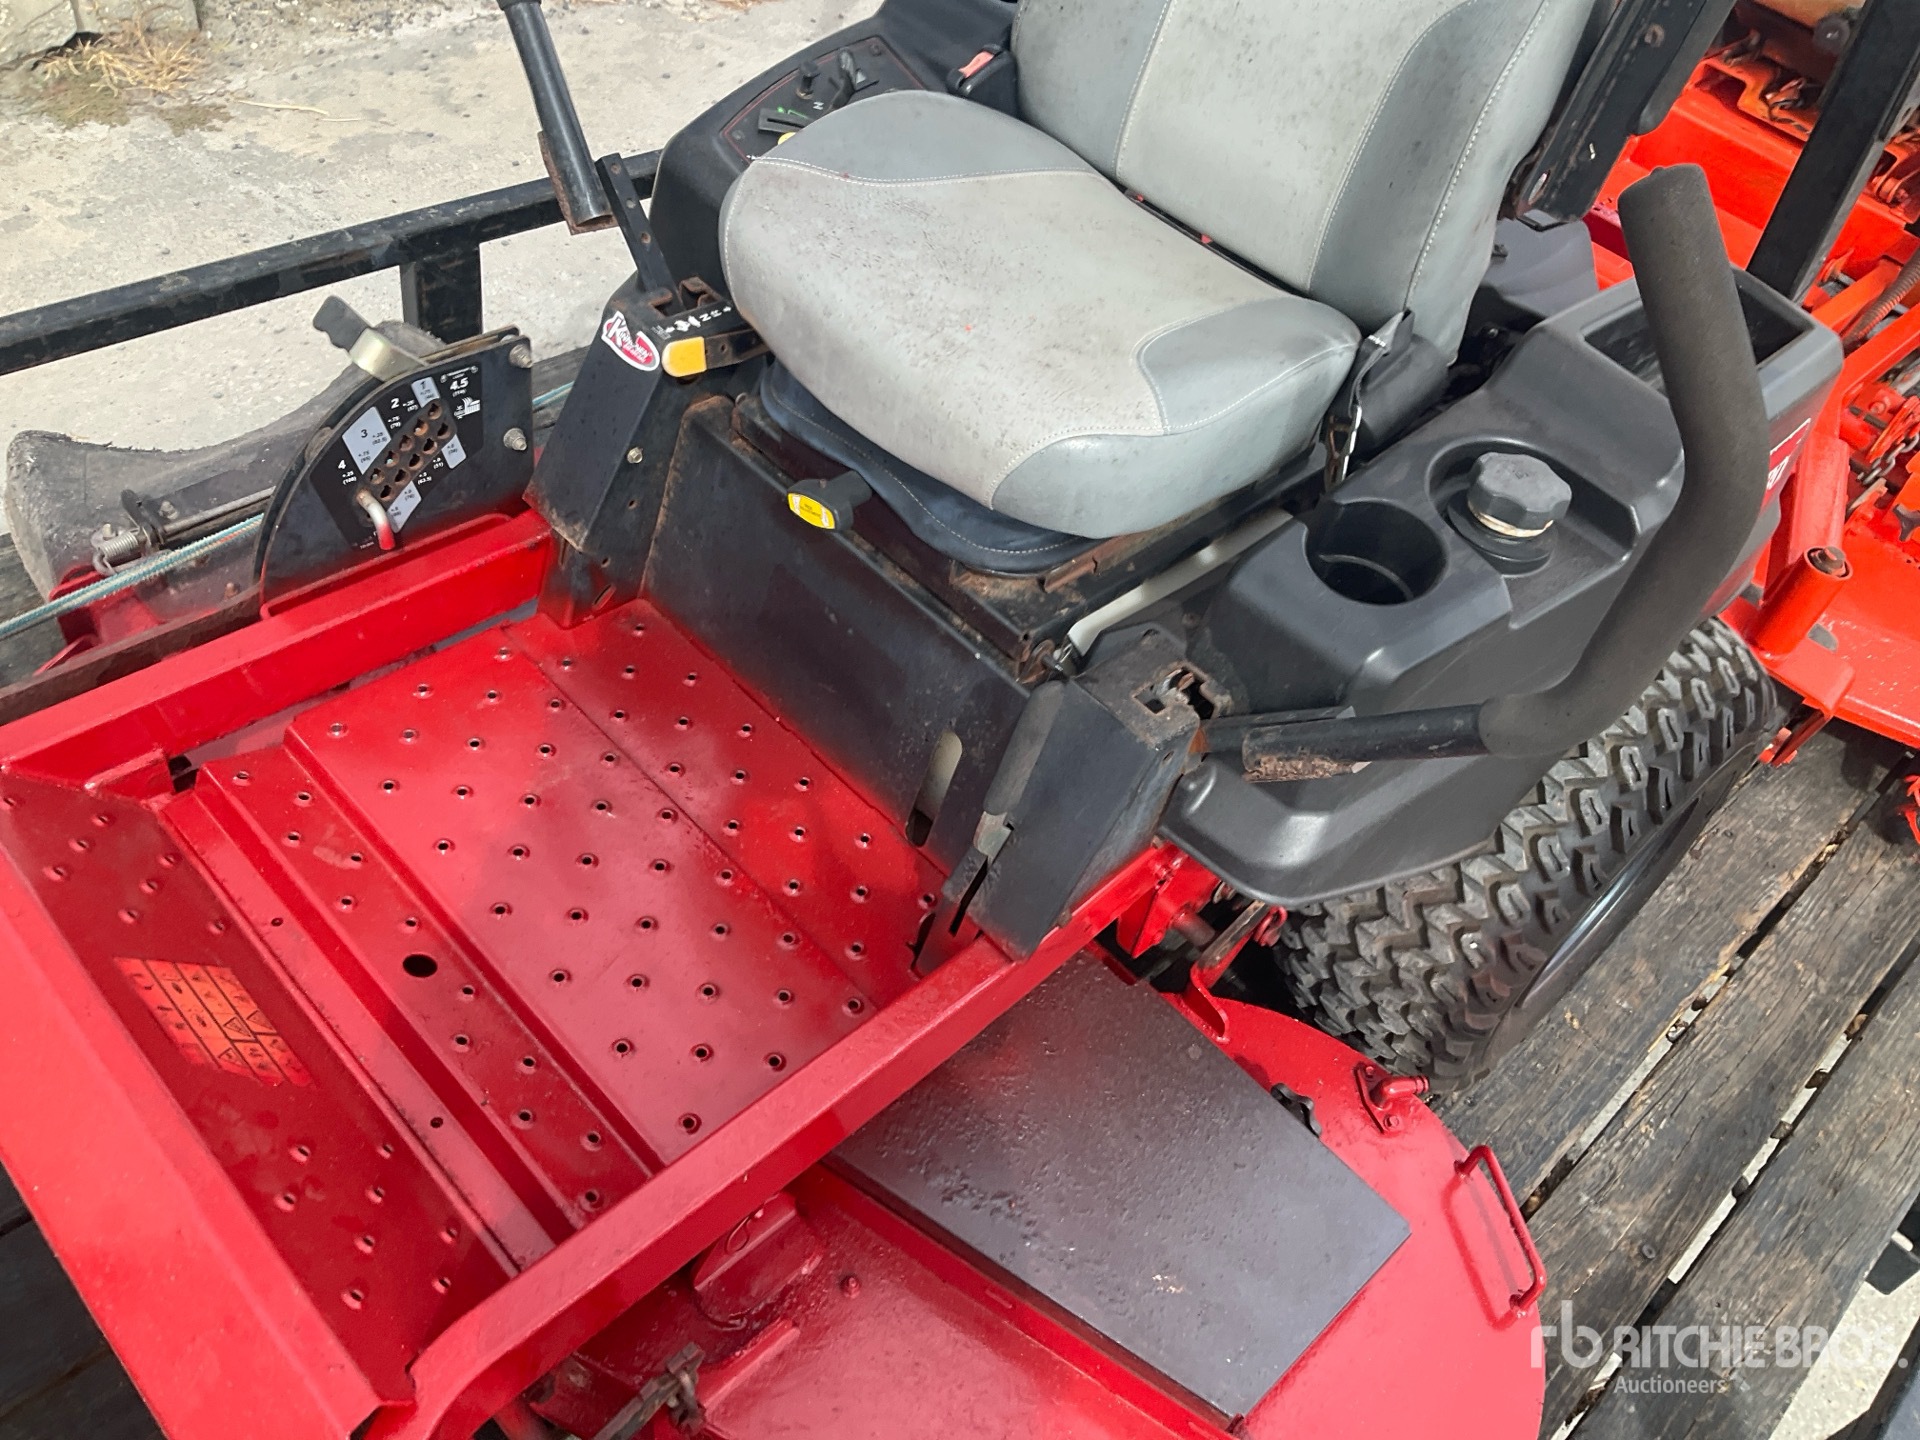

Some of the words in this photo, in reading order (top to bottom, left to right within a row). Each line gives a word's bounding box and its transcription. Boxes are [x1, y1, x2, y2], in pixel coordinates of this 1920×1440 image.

[420, 380, 426, 390] 1
[450, 377, 469, 390] 4.5
[391, 398, 400, 409] 2
[360, 429, 368, 438] 3
[338, 460, 346, 470] 4
